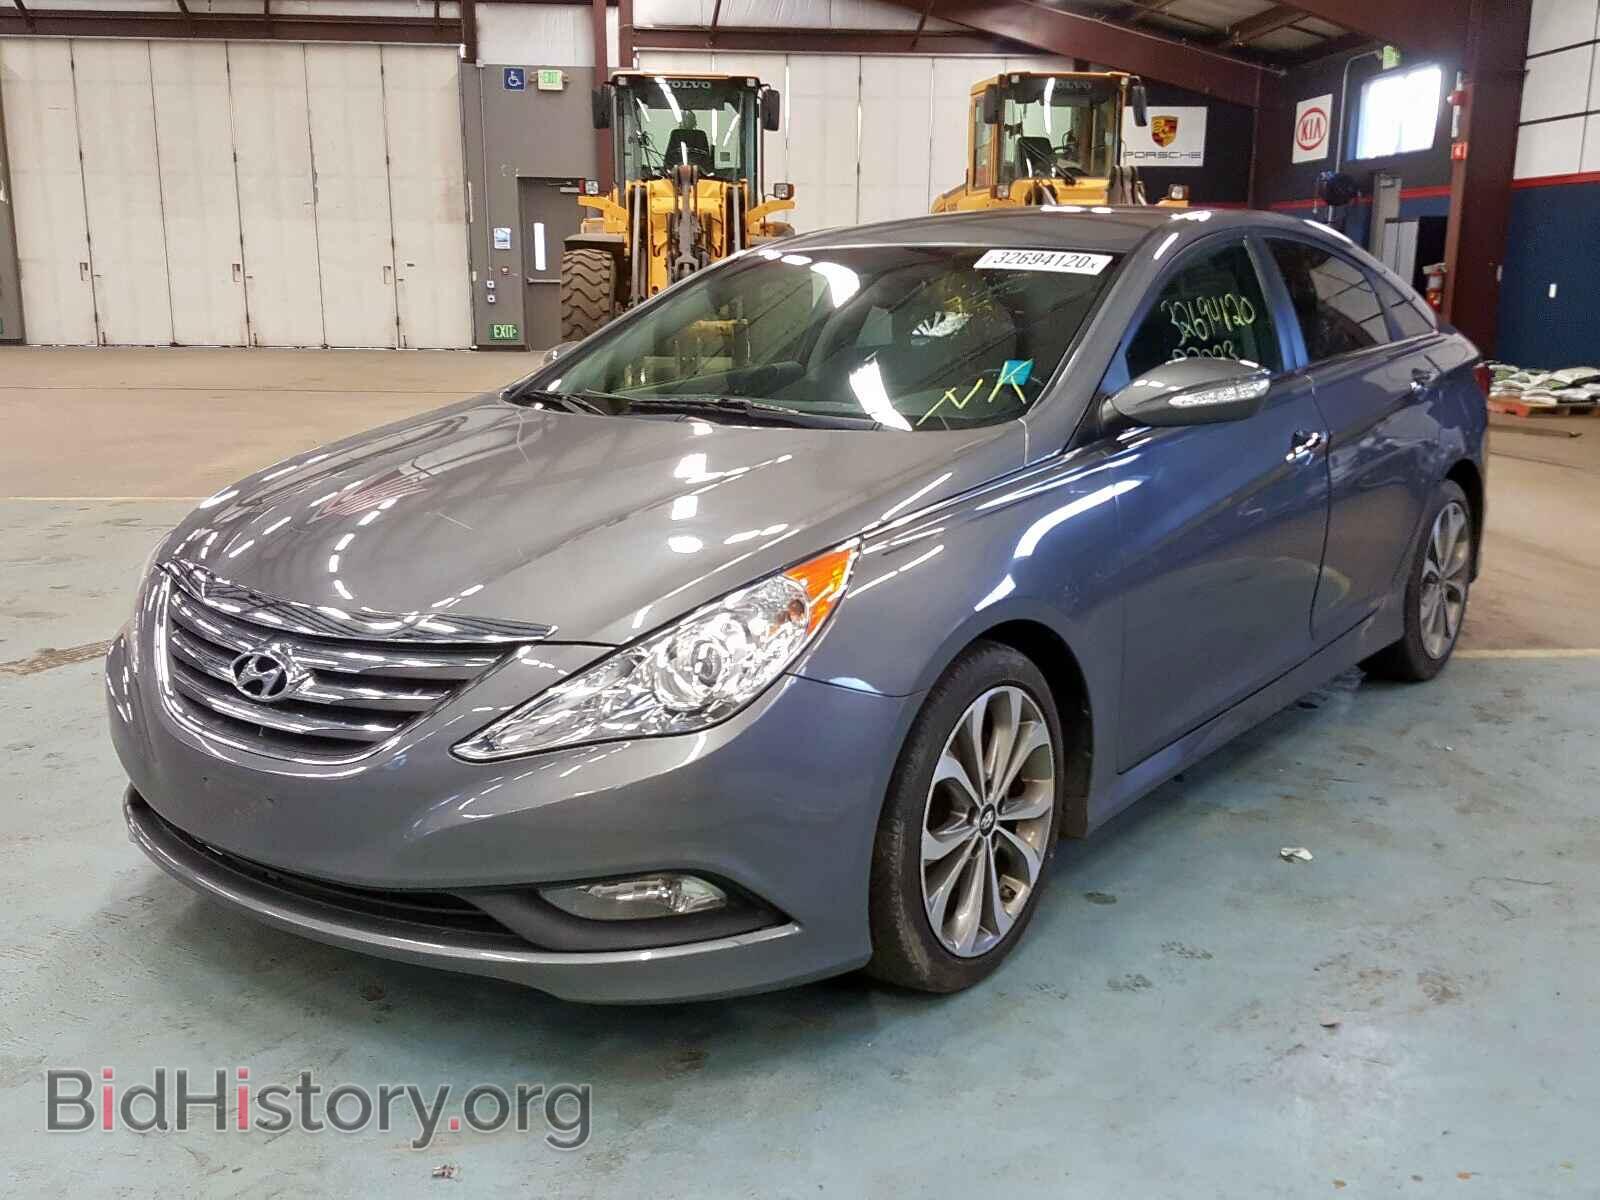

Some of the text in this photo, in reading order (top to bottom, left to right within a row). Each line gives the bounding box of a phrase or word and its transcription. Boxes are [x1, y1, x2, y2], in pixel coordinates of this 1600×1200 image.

[666, 80, 711, 89] OLVO
[1123, 151, 1201, 160] PORSCHE
[1160, 293, 1255, 346] 32694120
[494, 325, 513, 338] EXIT
